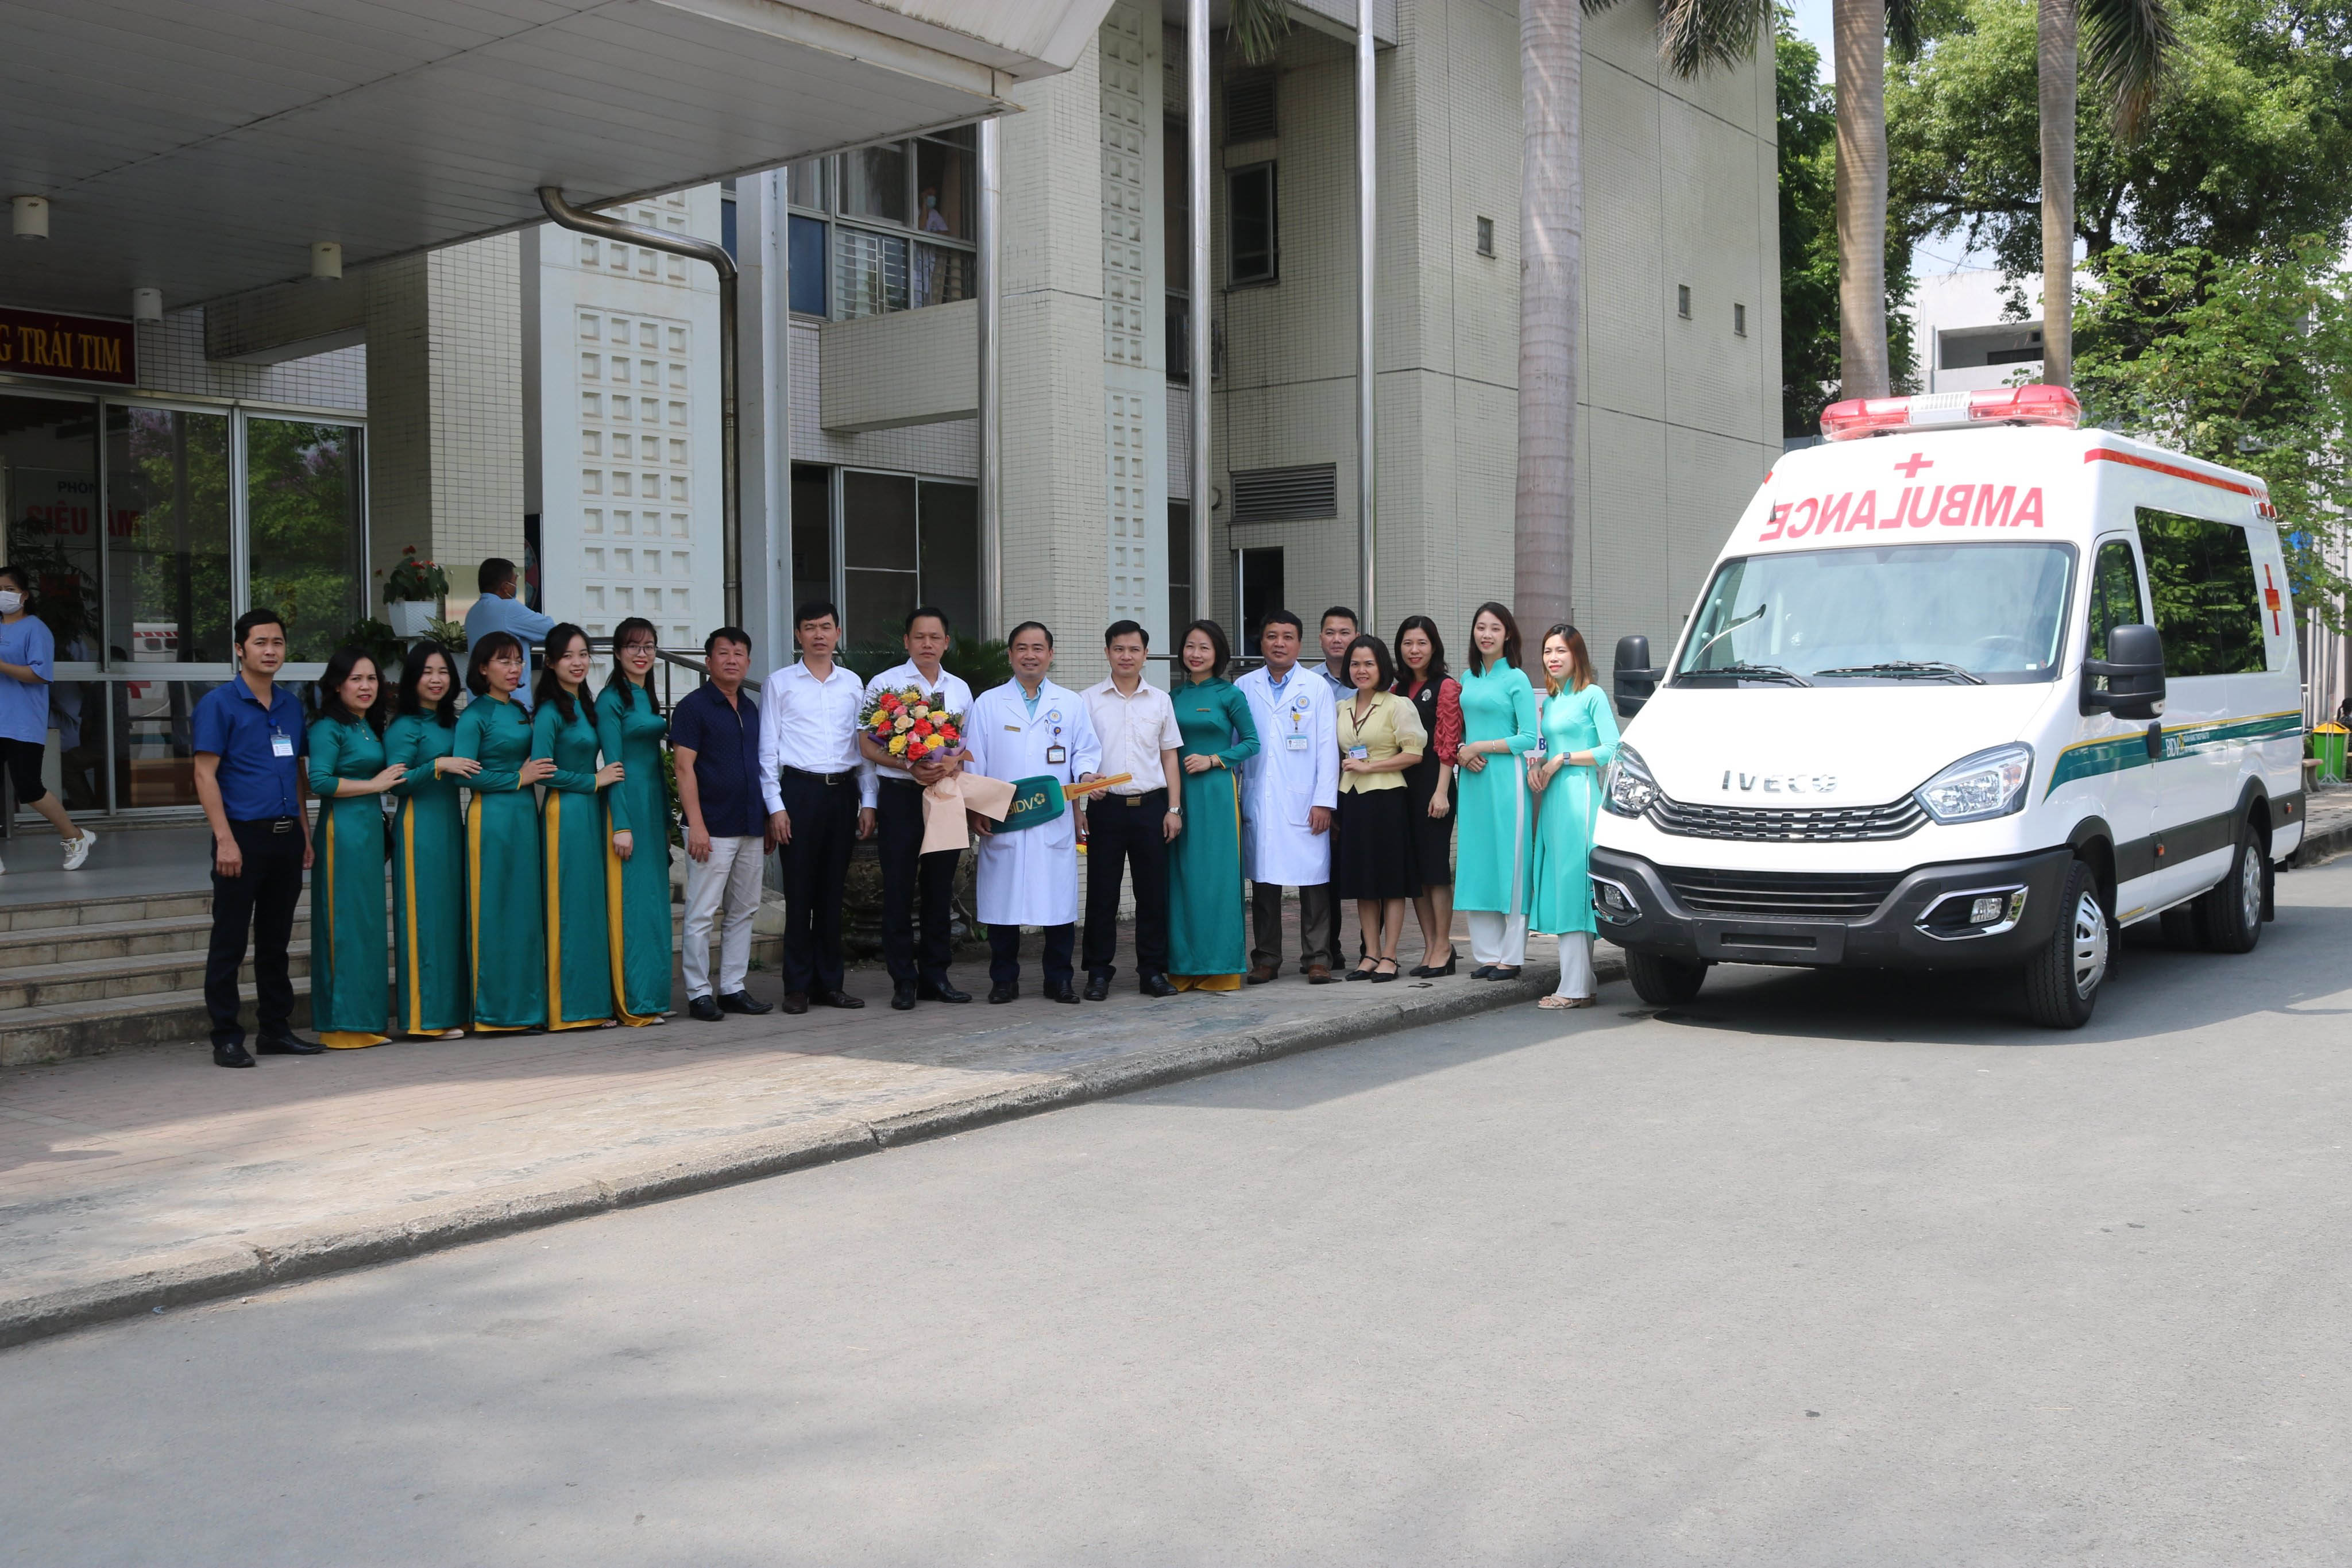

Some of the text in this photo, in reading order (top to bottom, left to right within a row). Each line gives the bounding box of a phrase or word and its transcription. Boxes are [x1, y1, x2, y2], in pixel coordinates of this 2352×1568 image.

[18, 322, 73, 368] TRÁI
[78, 333, 122, 373] TIM
[1722, 770, 1838, 793] IVECO
